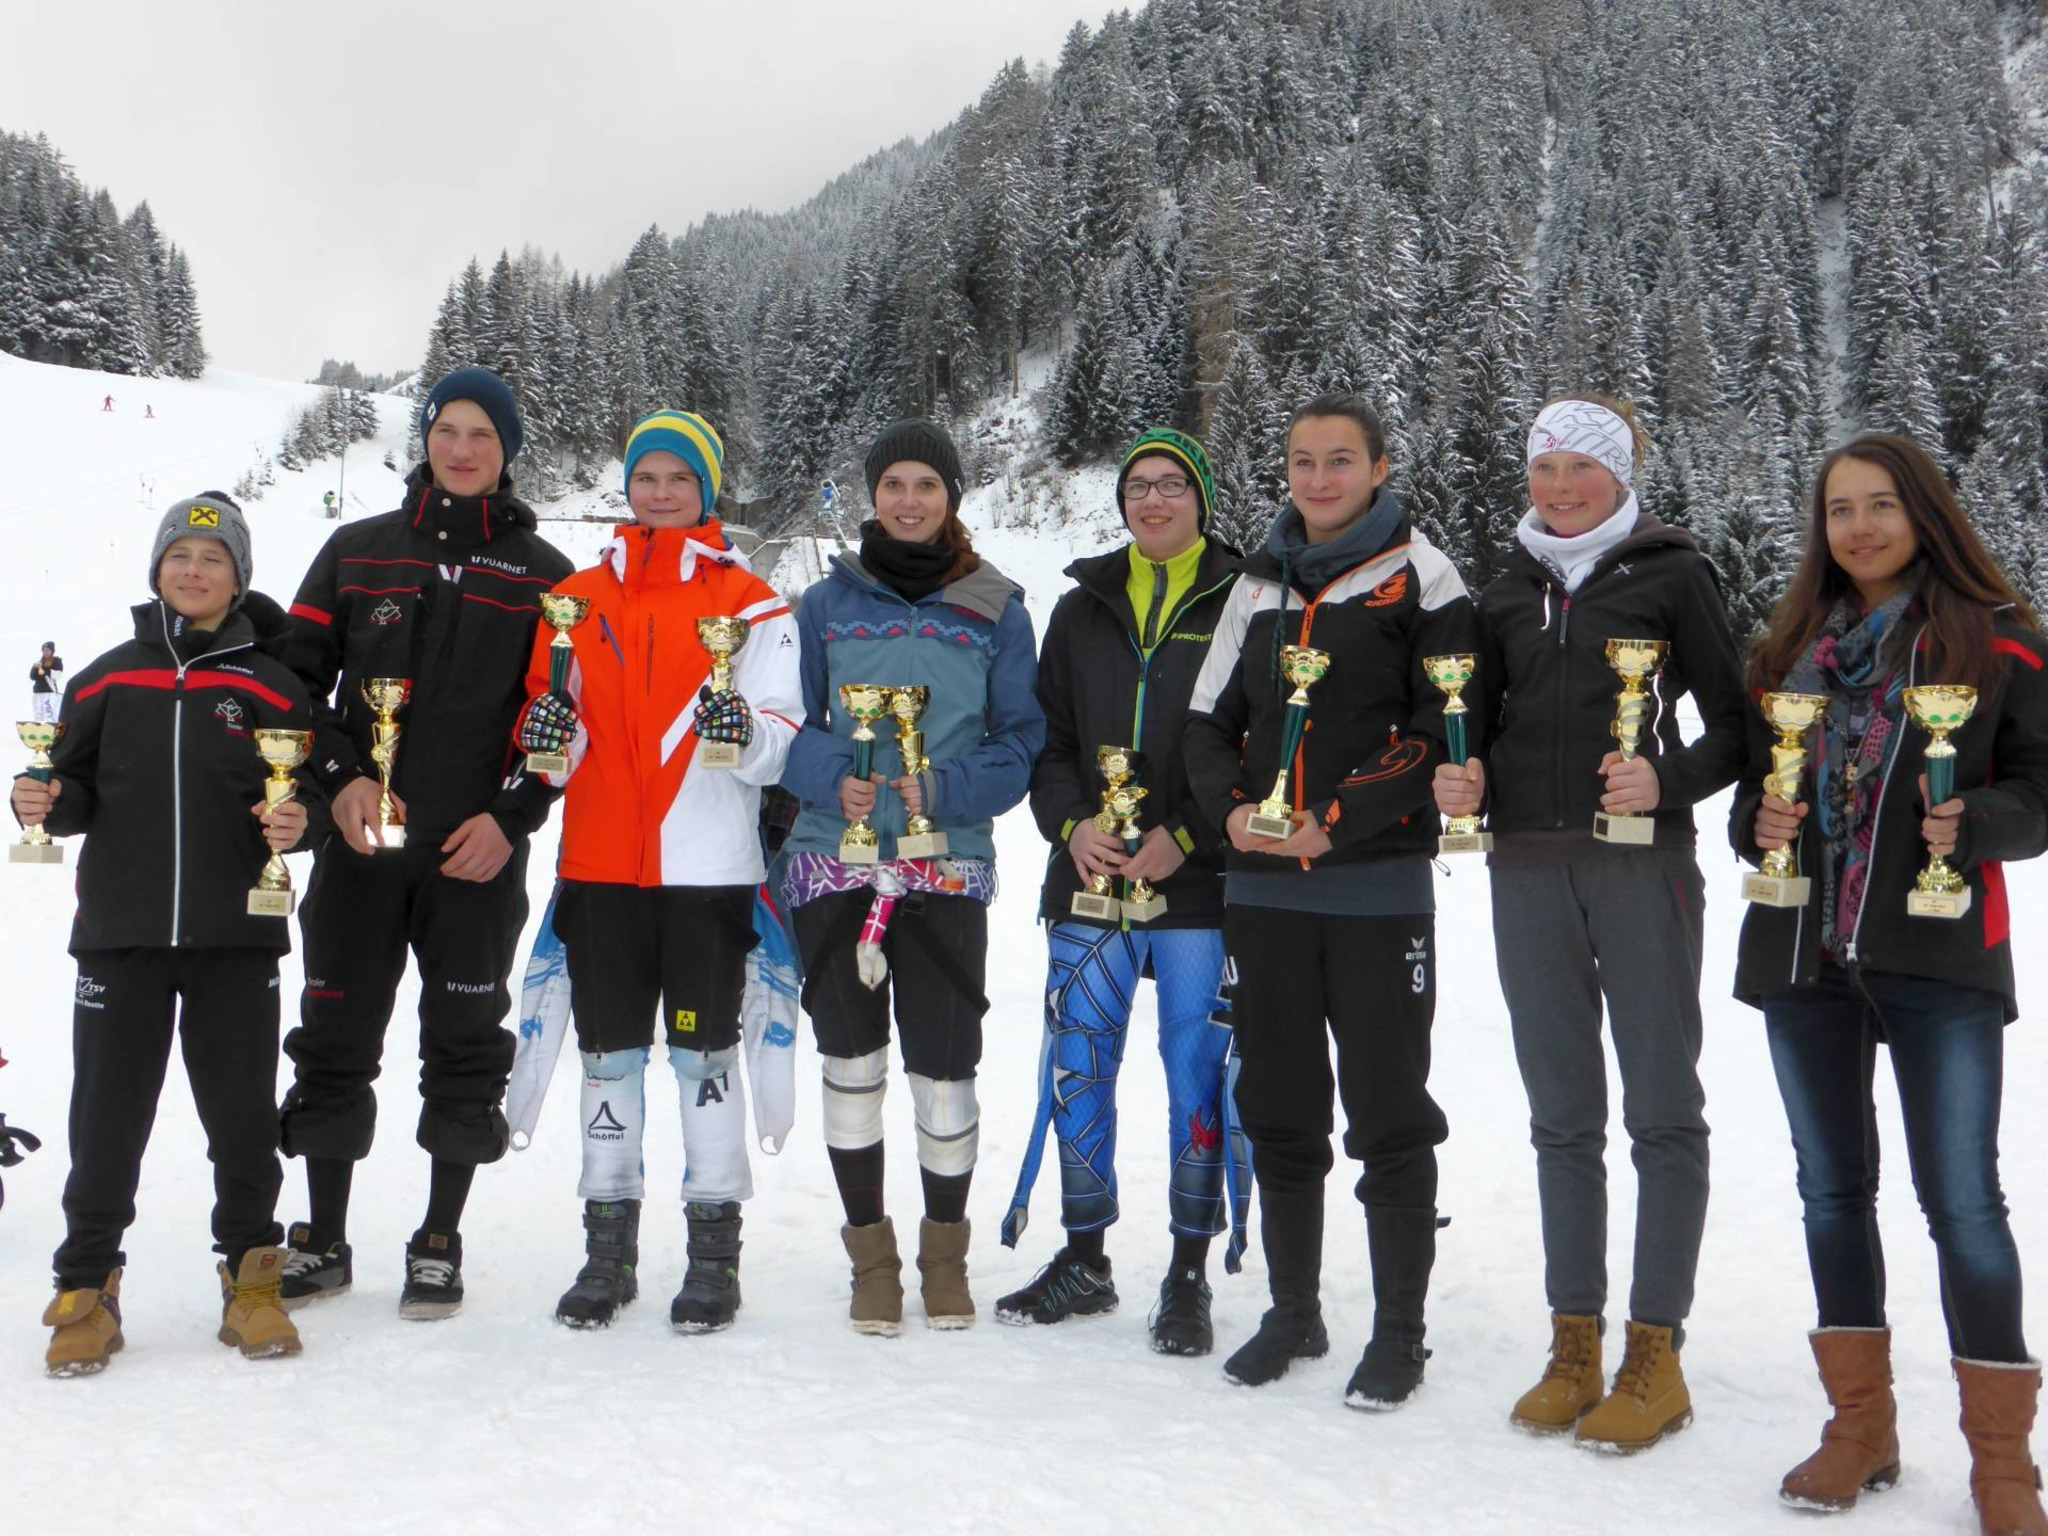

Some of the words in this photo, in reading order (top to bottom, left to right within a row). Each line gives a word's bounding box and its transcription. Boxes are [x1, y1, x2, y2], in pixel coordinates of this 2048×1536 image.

[482, 556, 527, 575] VUARNET
[1178, 632, 1212, 642] PROTEST
[1411, 963, 1425, 994] 9
[89, 984, 106, 993] TSV
[586, 1131, 624, 1141] Schöffel
